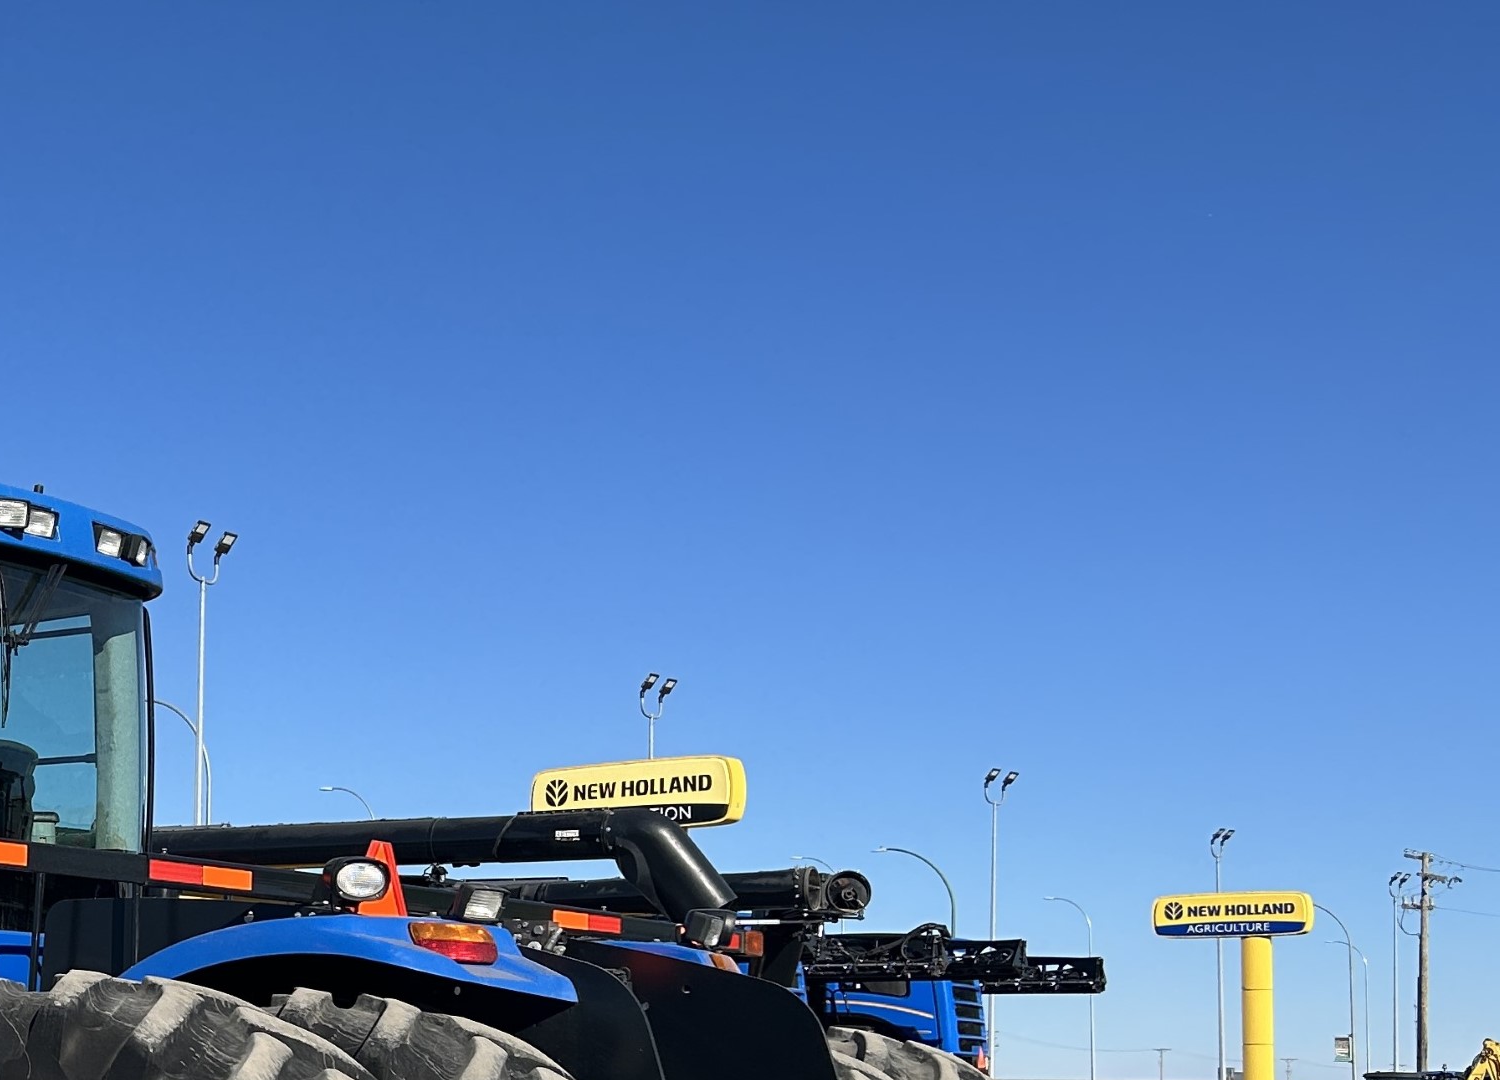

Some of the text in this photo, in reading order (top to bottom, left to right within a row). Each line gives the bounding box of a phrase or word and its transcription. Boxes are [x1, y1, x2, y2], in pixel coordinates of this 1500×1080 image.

[573, 774, 712, 801] NEW HOLLAND
[1187, 902, 1295, 917] NEW HOLLAND
[1186, 922, 1270, 933] AGRICULTURE
